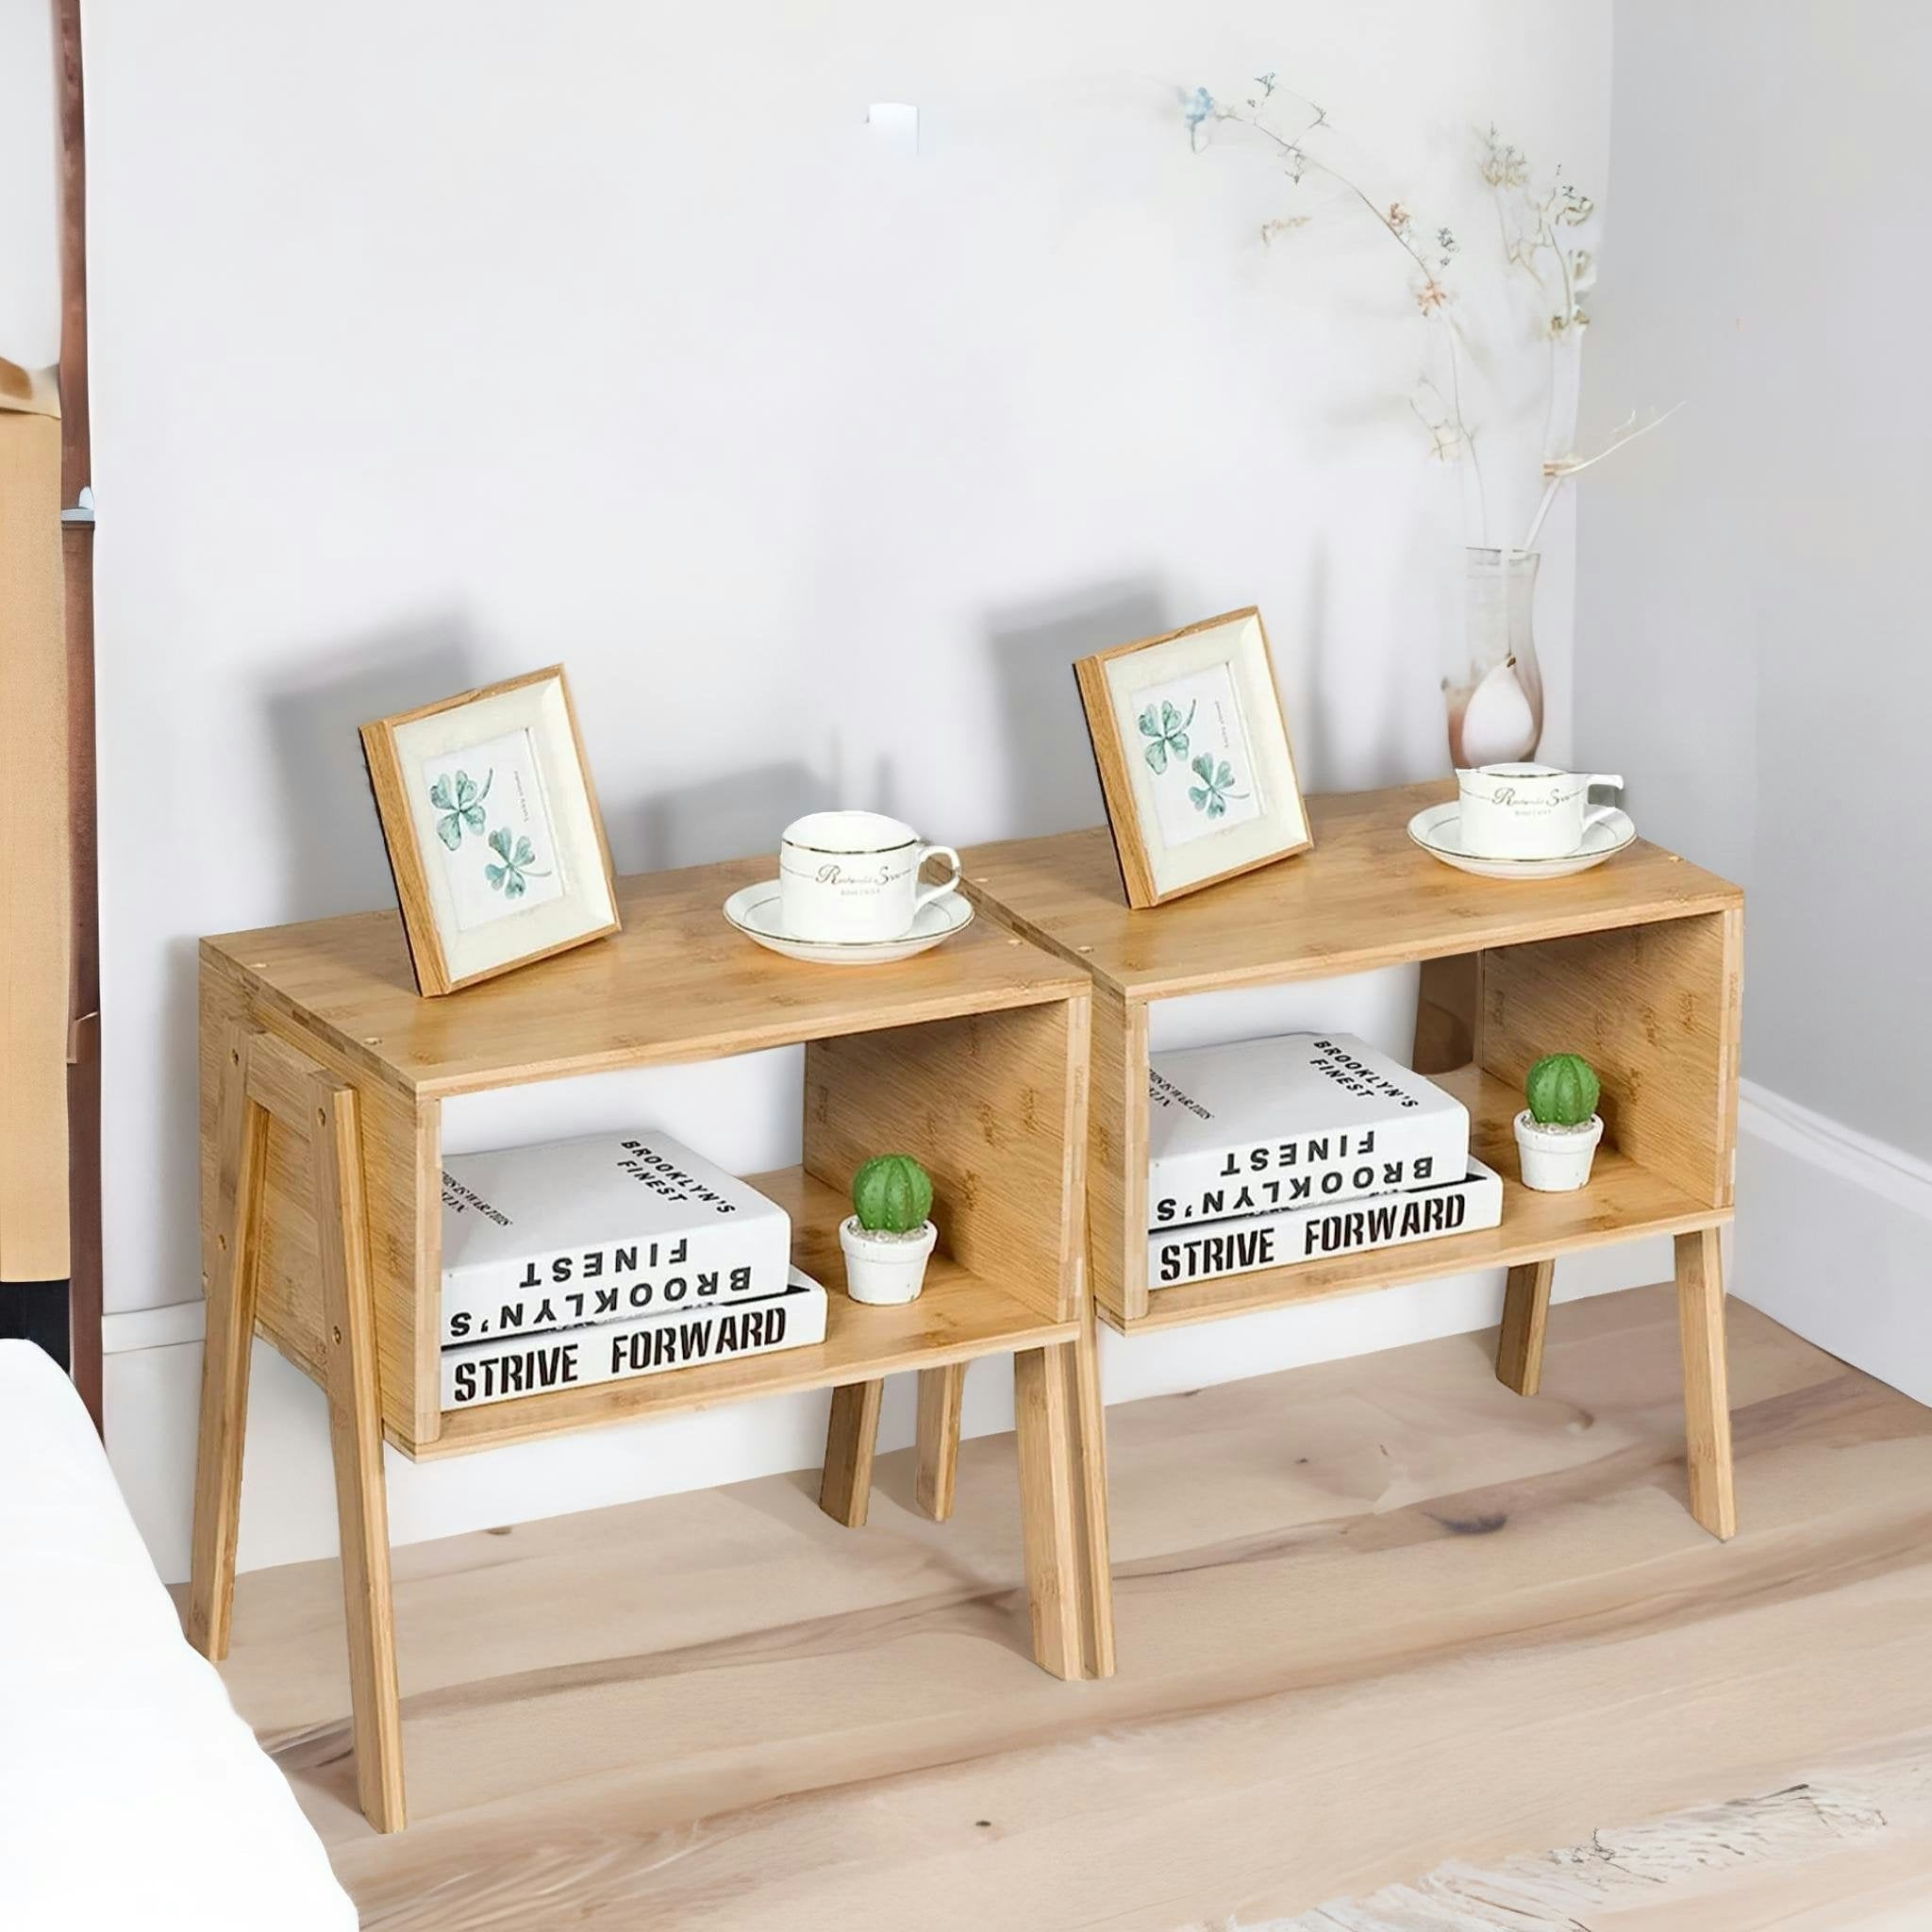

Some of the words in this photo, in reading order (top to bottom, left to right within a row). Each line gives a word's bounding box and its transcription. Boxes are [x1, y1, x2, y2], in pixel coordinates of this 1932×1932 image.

[1308, 1058, 1374, 1098] FINEST
[1313, 1040, 1420, 1108] BROOKLYN'S
[616, 1159, 689, 1204] FINEST
[620, 1139, 736, 1215] BROOKLYN'S
[1220, 1130, 1375, 1177] FINEST
[1157, 1156, 1434, 1223] BROOKLYN'S
[519, 1238, 689, 1290] FINEST
[1159, 1226, 1275, 1282] STRIVE
[1304, 1193, 1466, 1256] FORWARD
[449, 1265, 753, 1338] BROOKLYN'S
[453, 1343, 579, 1402] STRIVE
[610, 1307, 787, 1374] FORWARD
